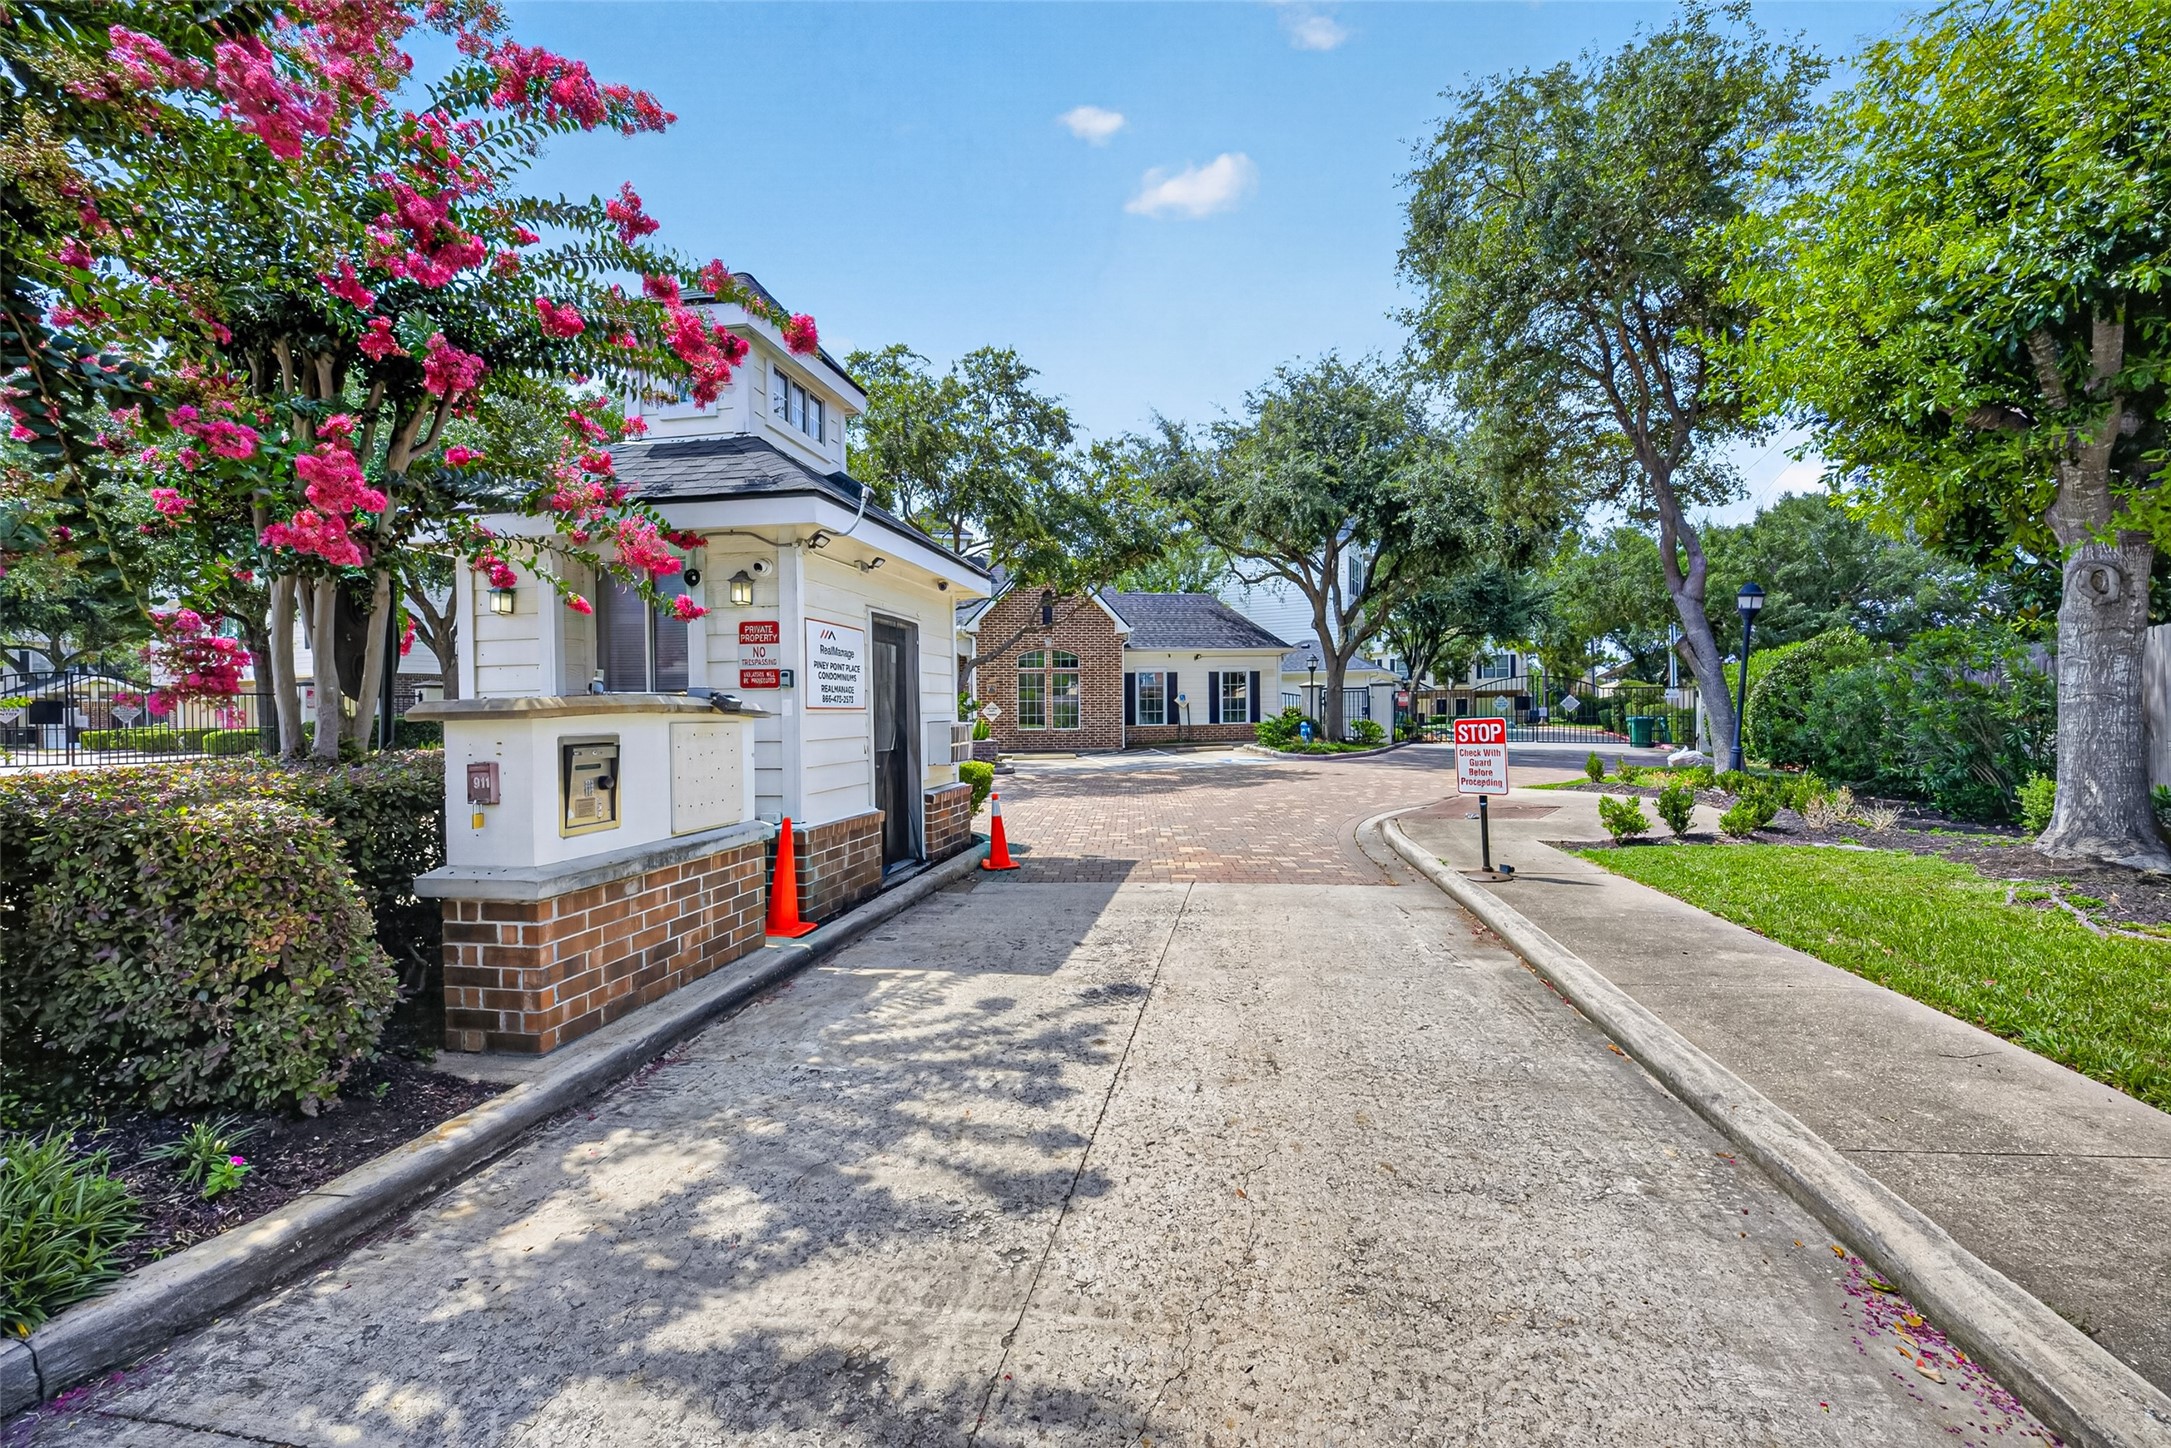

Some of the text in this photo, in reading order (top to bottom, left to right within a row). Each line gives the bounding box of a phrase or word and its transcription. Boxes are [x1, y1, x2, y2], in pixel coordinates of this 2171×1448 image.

[744, 625, 773, 634] PRIVATE
[740, 634, 778, 642] PROPERTY
[752, 646, 766, 658] NO
[820, 644, 854, 660] RealManage
[814, 660, 860, 674] PINEY POINT PLACE
[818, 671, 856, 682] CONDOMINIUMS
[820, 684, 854, 694] REALMANAGE
[1458, 723, 1502, 742] STOP
[1460, 748, 1501, 757] Check With
[1470, 758, 1492, 766] Guard
[1468, 768, 1493, 776] Before
[474, 776, 490, 788] 911
[1461, 778, 1502, 788] Proceeding
